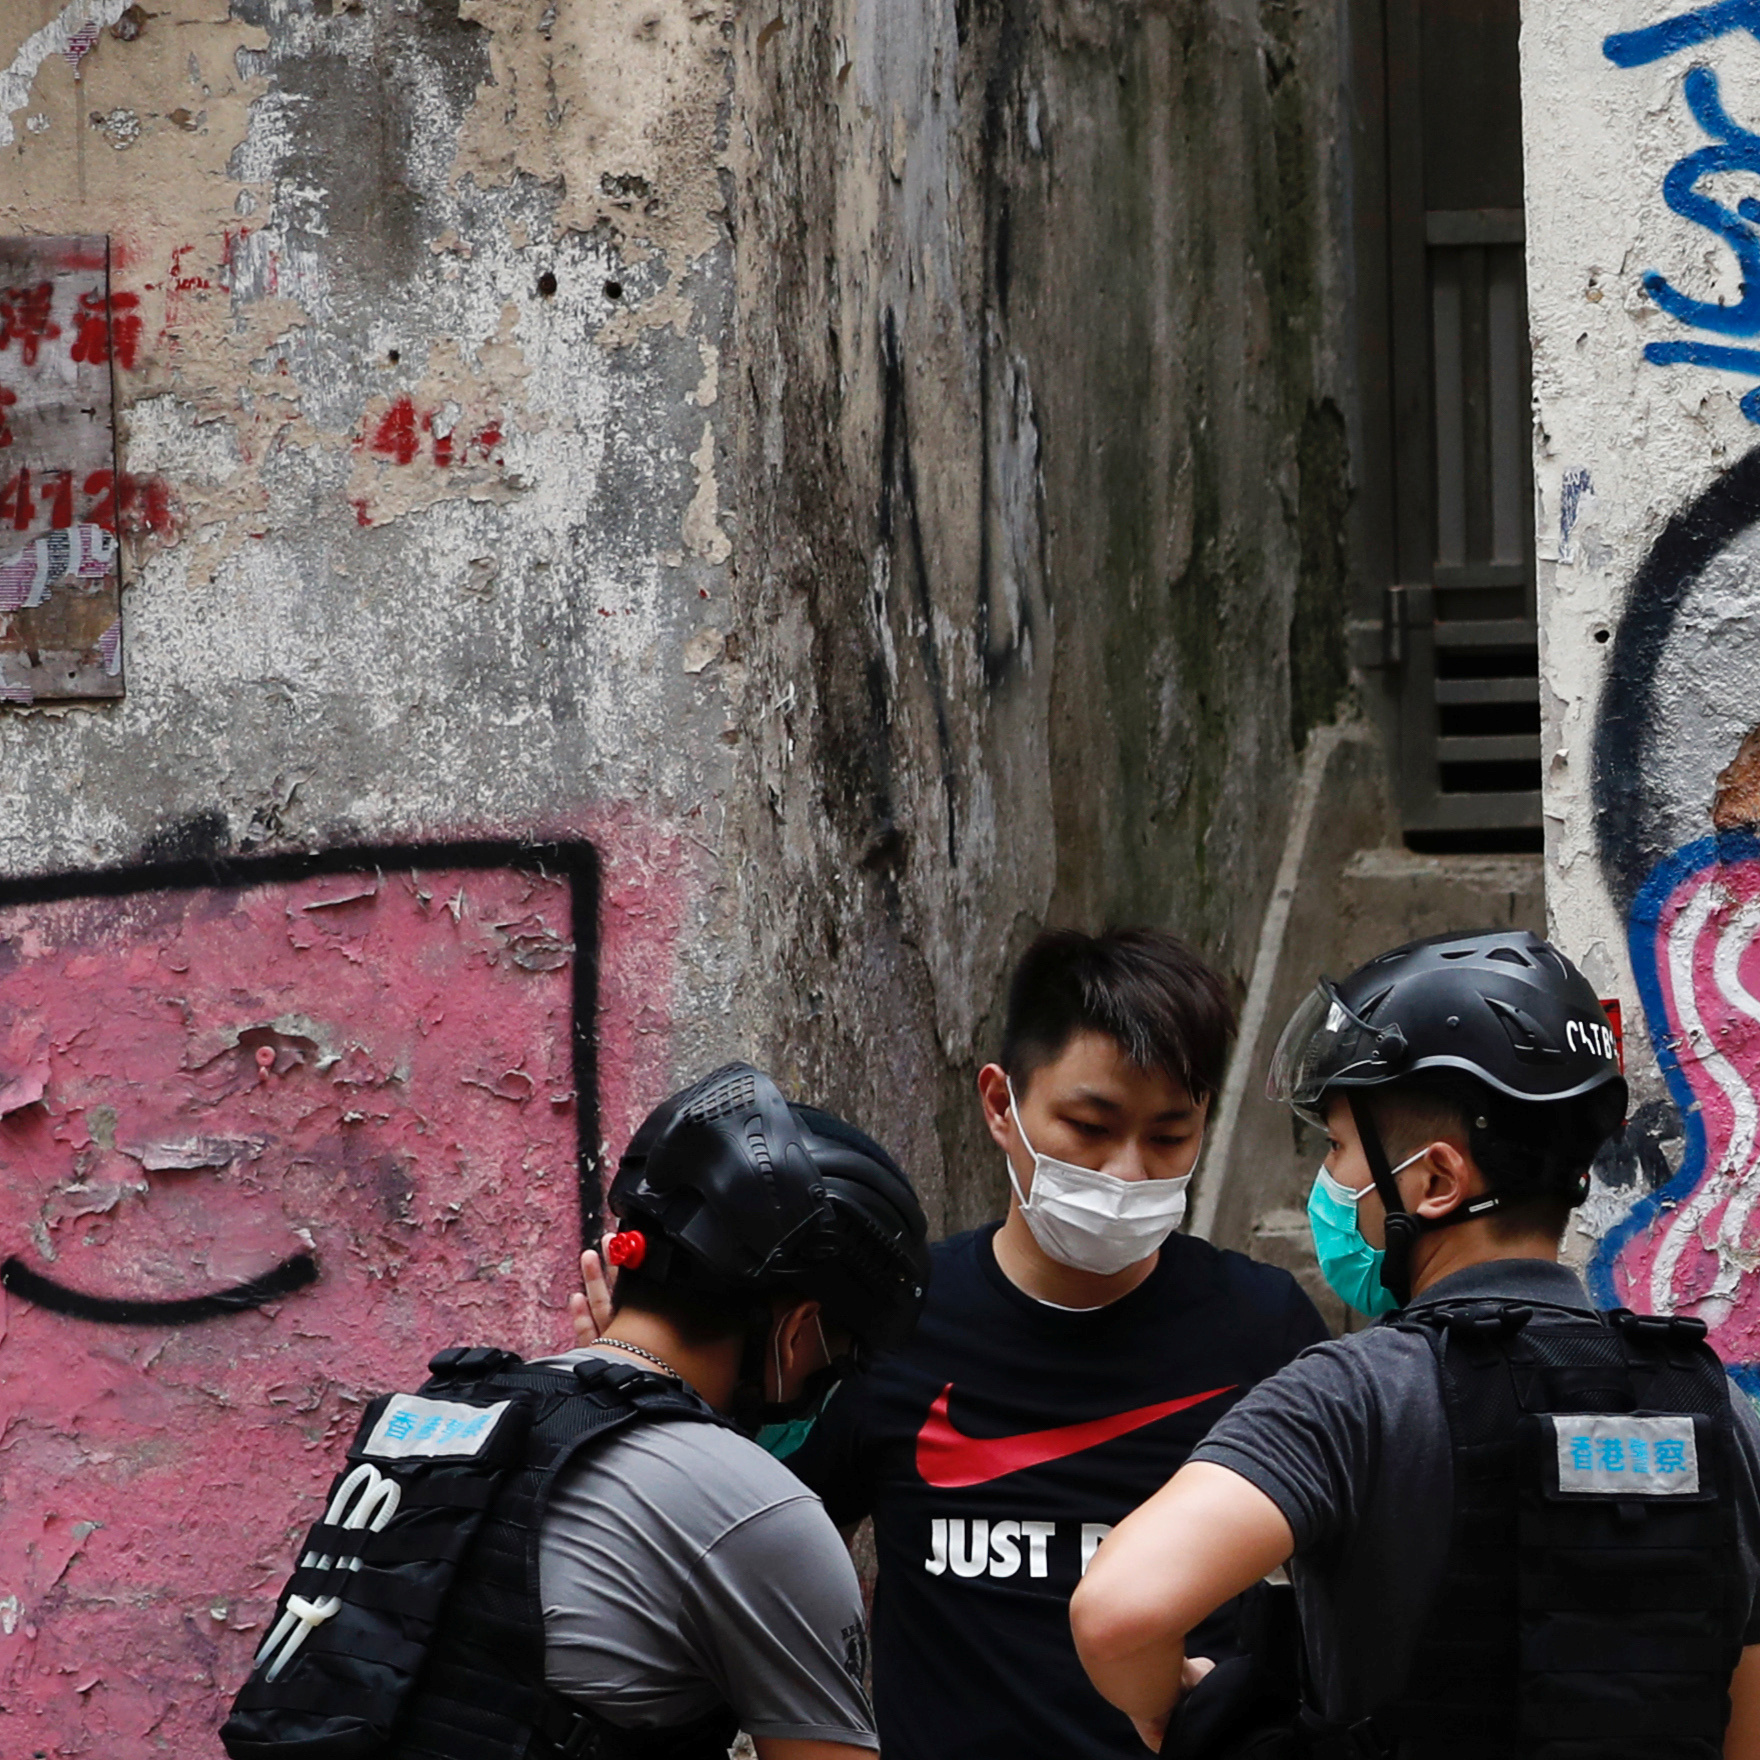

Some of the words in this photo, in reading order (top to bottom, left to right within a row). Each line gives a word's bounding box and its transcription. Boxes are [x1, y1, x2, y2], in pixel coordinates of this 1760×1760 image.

[1570, 1436, 1687, 1474] 香港警察
[925, 1518, 1056, 1578] JUST
